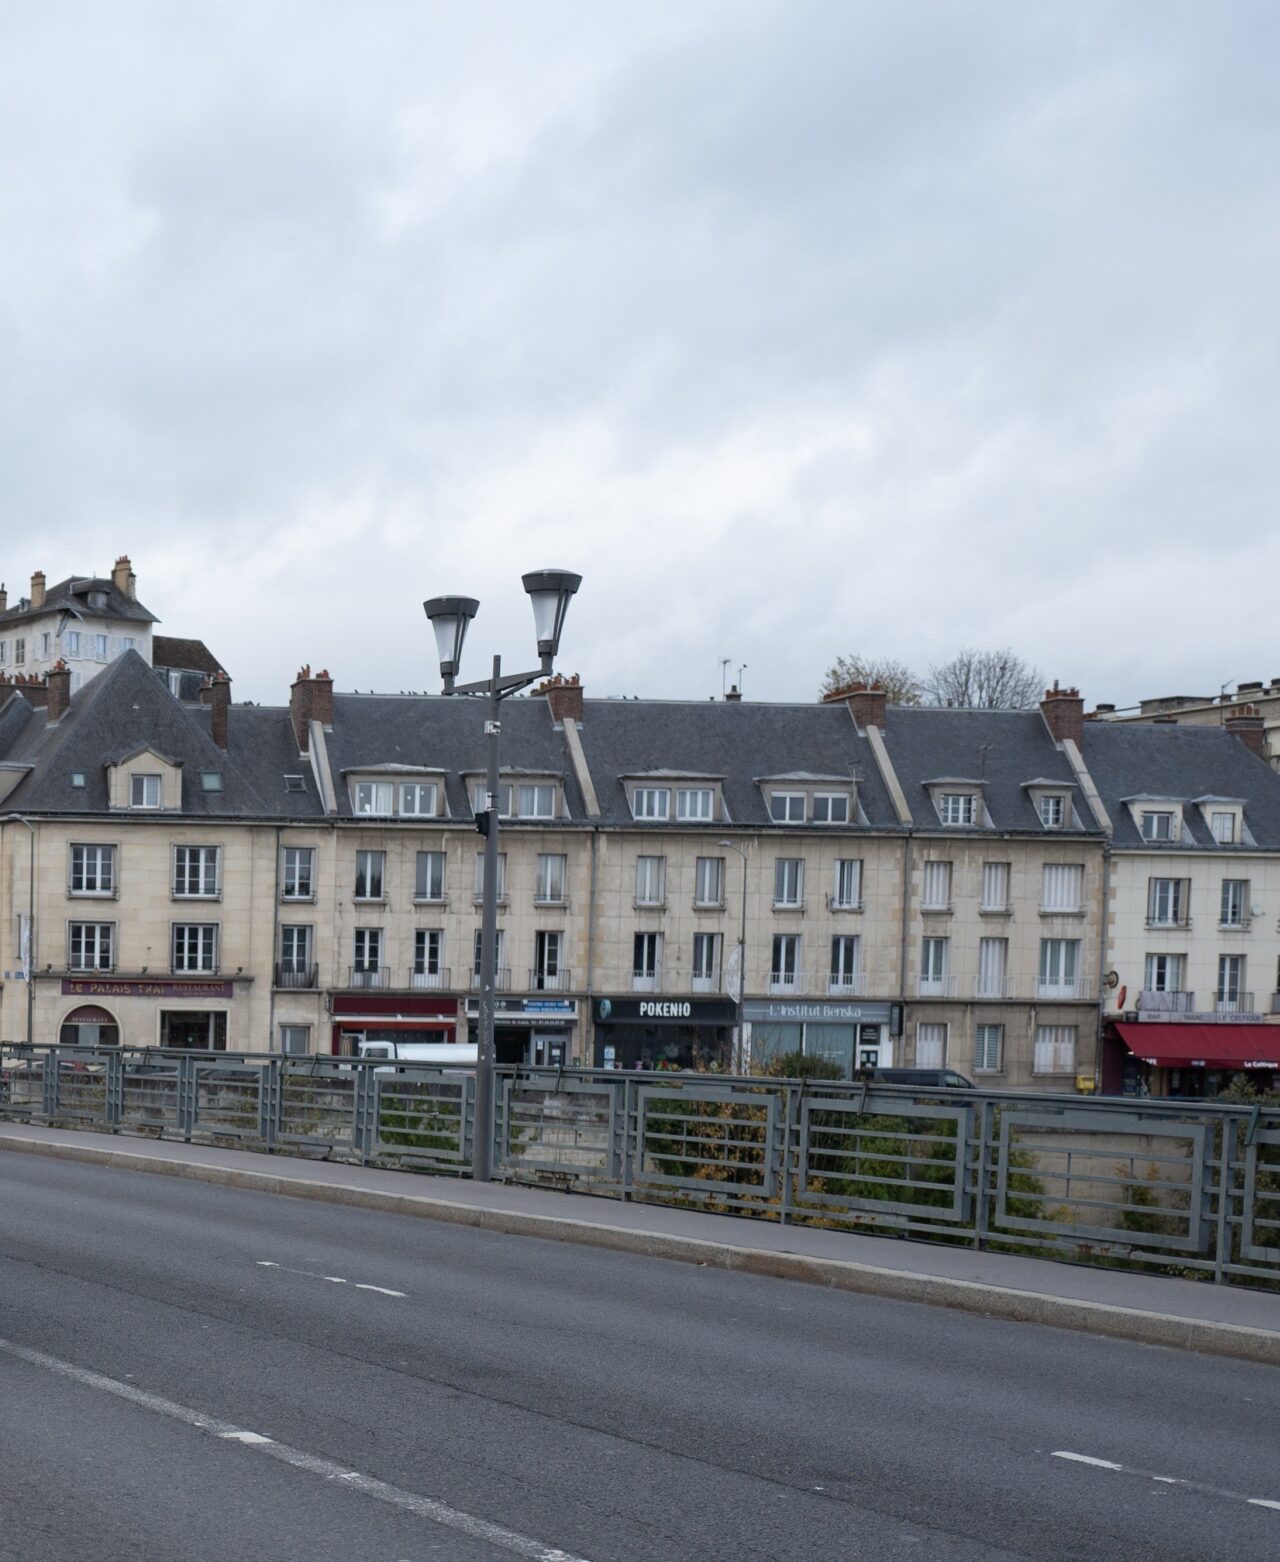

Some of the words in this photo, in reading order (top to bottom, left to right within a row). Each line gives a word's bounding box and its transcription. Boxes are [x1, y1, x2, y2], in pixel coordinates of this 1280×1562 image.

[70, 983, 83, 993] LE
[90, 984, 131, 994] PALAIS
[172, 984, 225, 992] RESTAURANT
[640, 1002, 691, 1017] POKENIO
[770, 1004, 820, 1017] L'Institut
[823, 1005, 862, 1017] Benska
